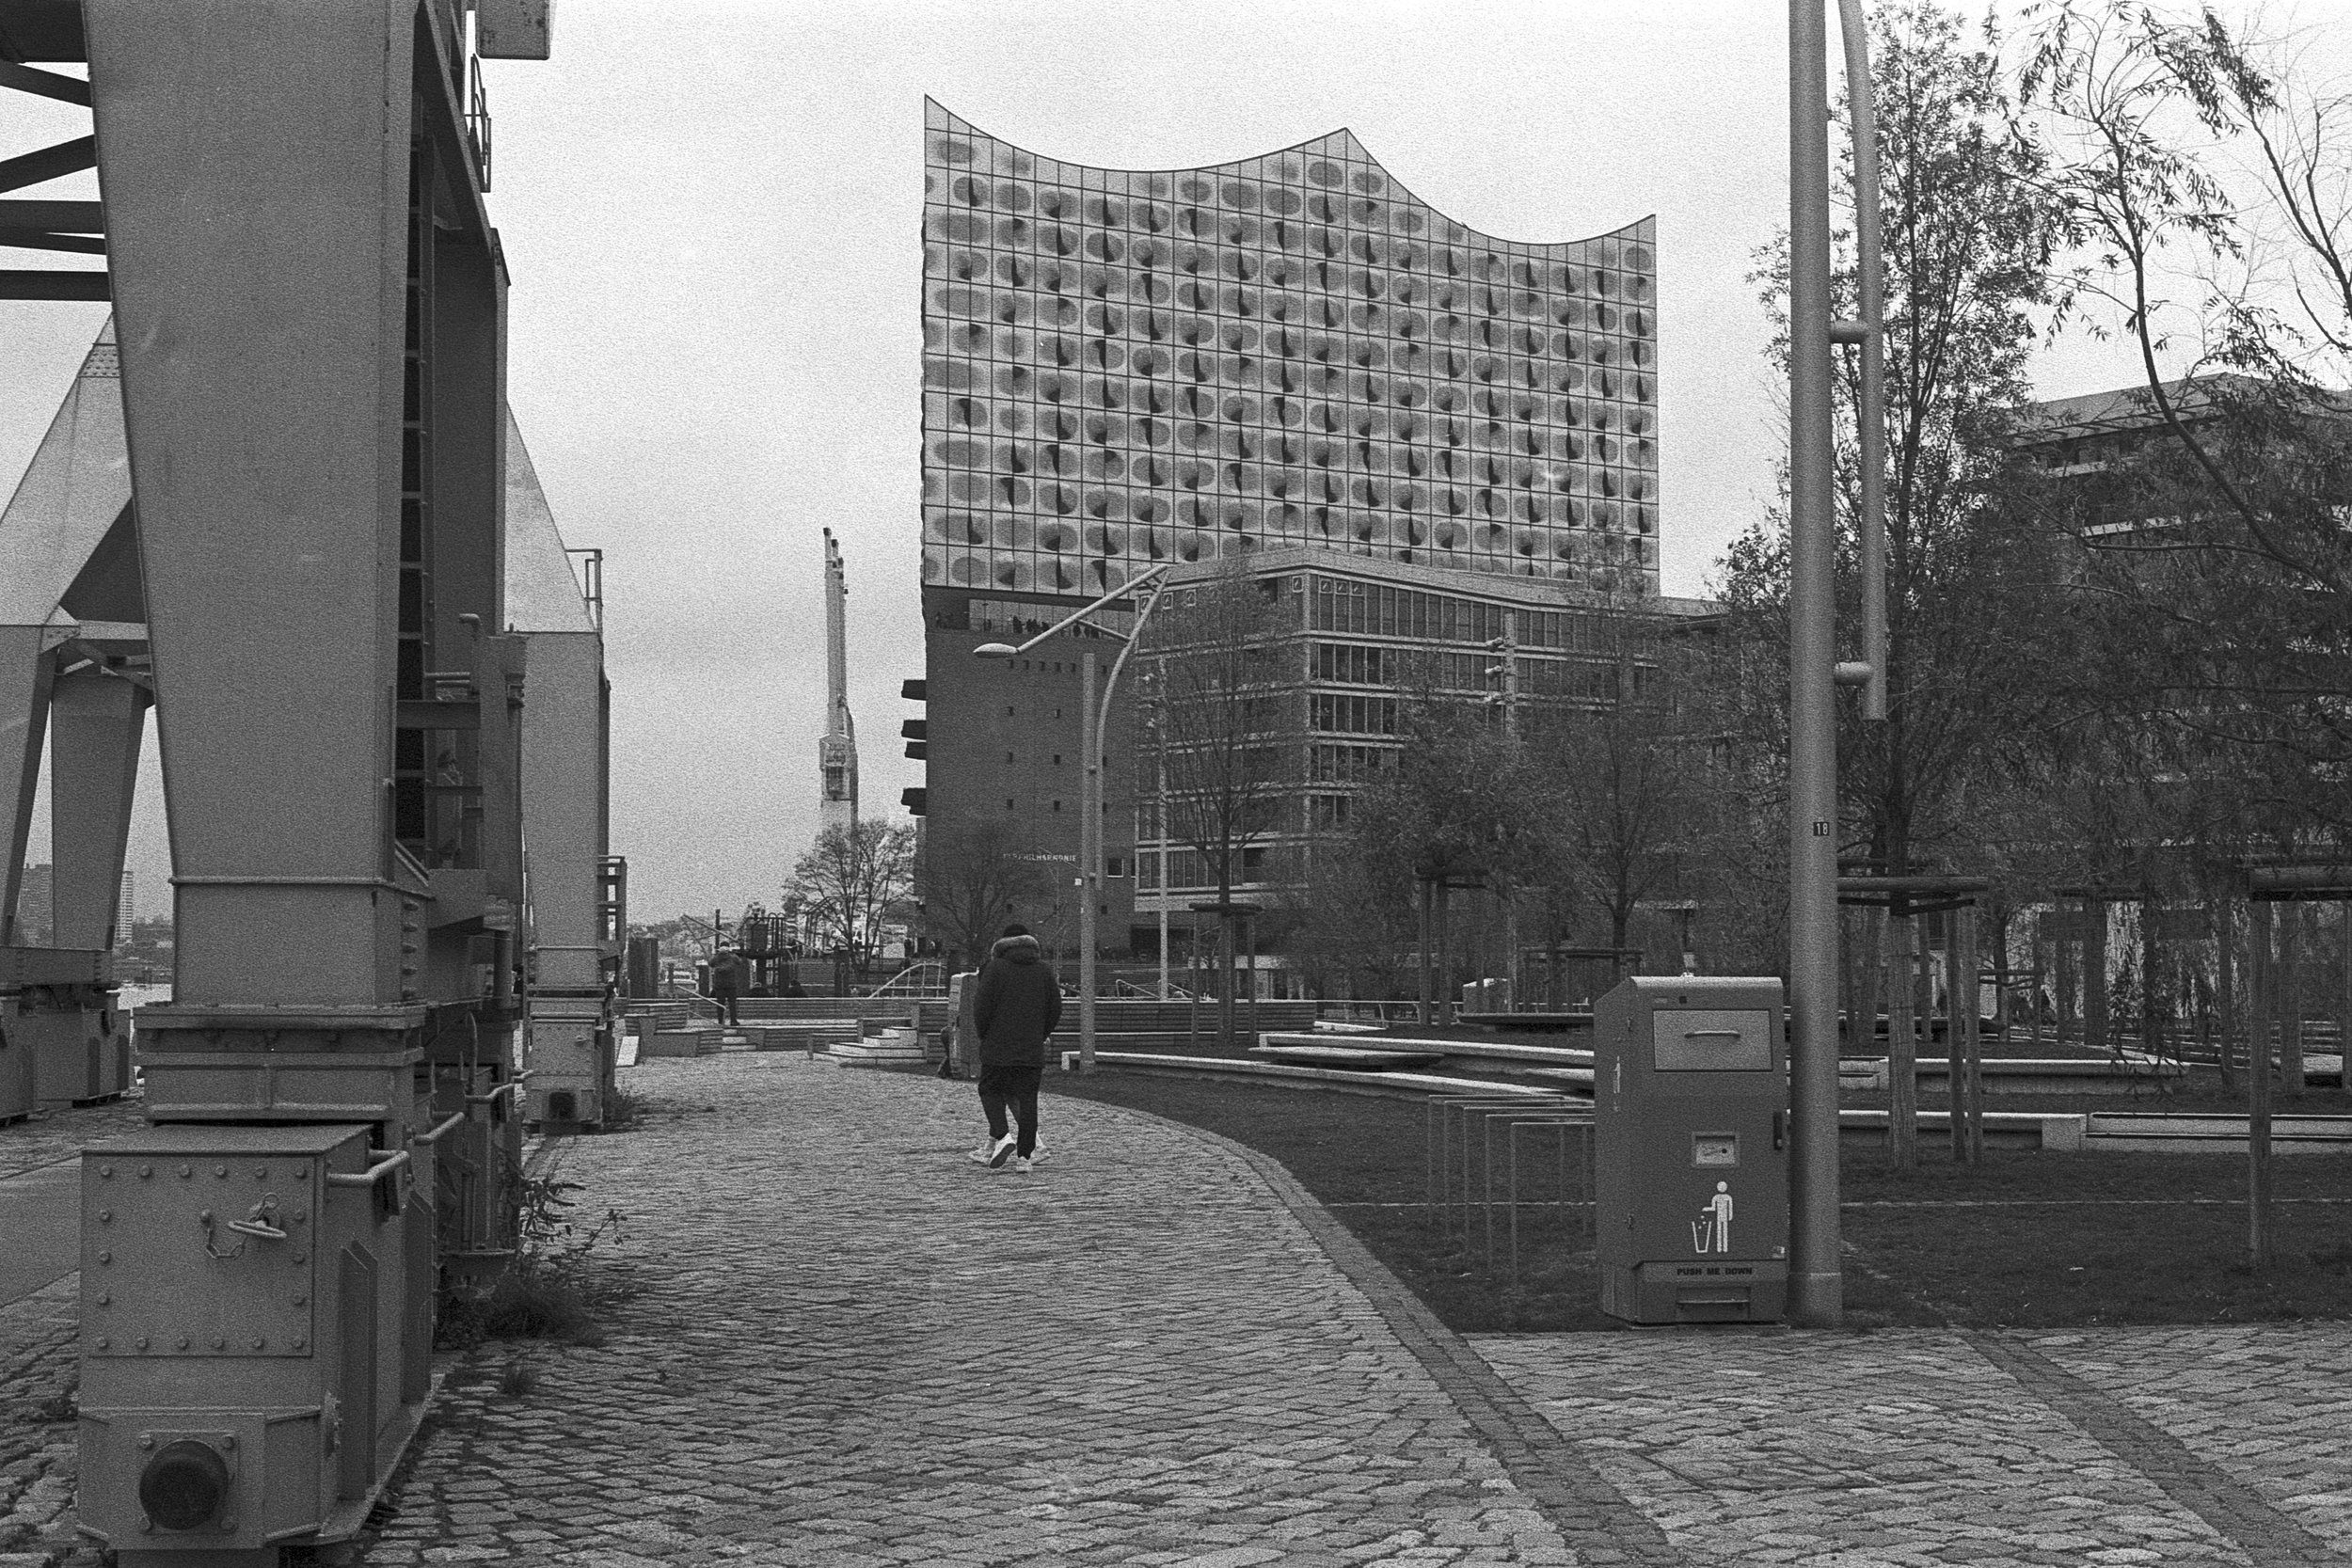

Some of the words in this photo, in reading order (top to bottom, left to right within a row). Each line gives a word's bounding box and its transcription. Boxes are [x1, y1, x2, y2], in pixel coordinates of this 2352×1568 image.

[1816, 822, 1828, 835] 18
[1677, 1267, 1702, 1275] PUSH
[1707, 1267, 1720, 1275] ME
[1724, 1267, 1752, 1275] DOWN
